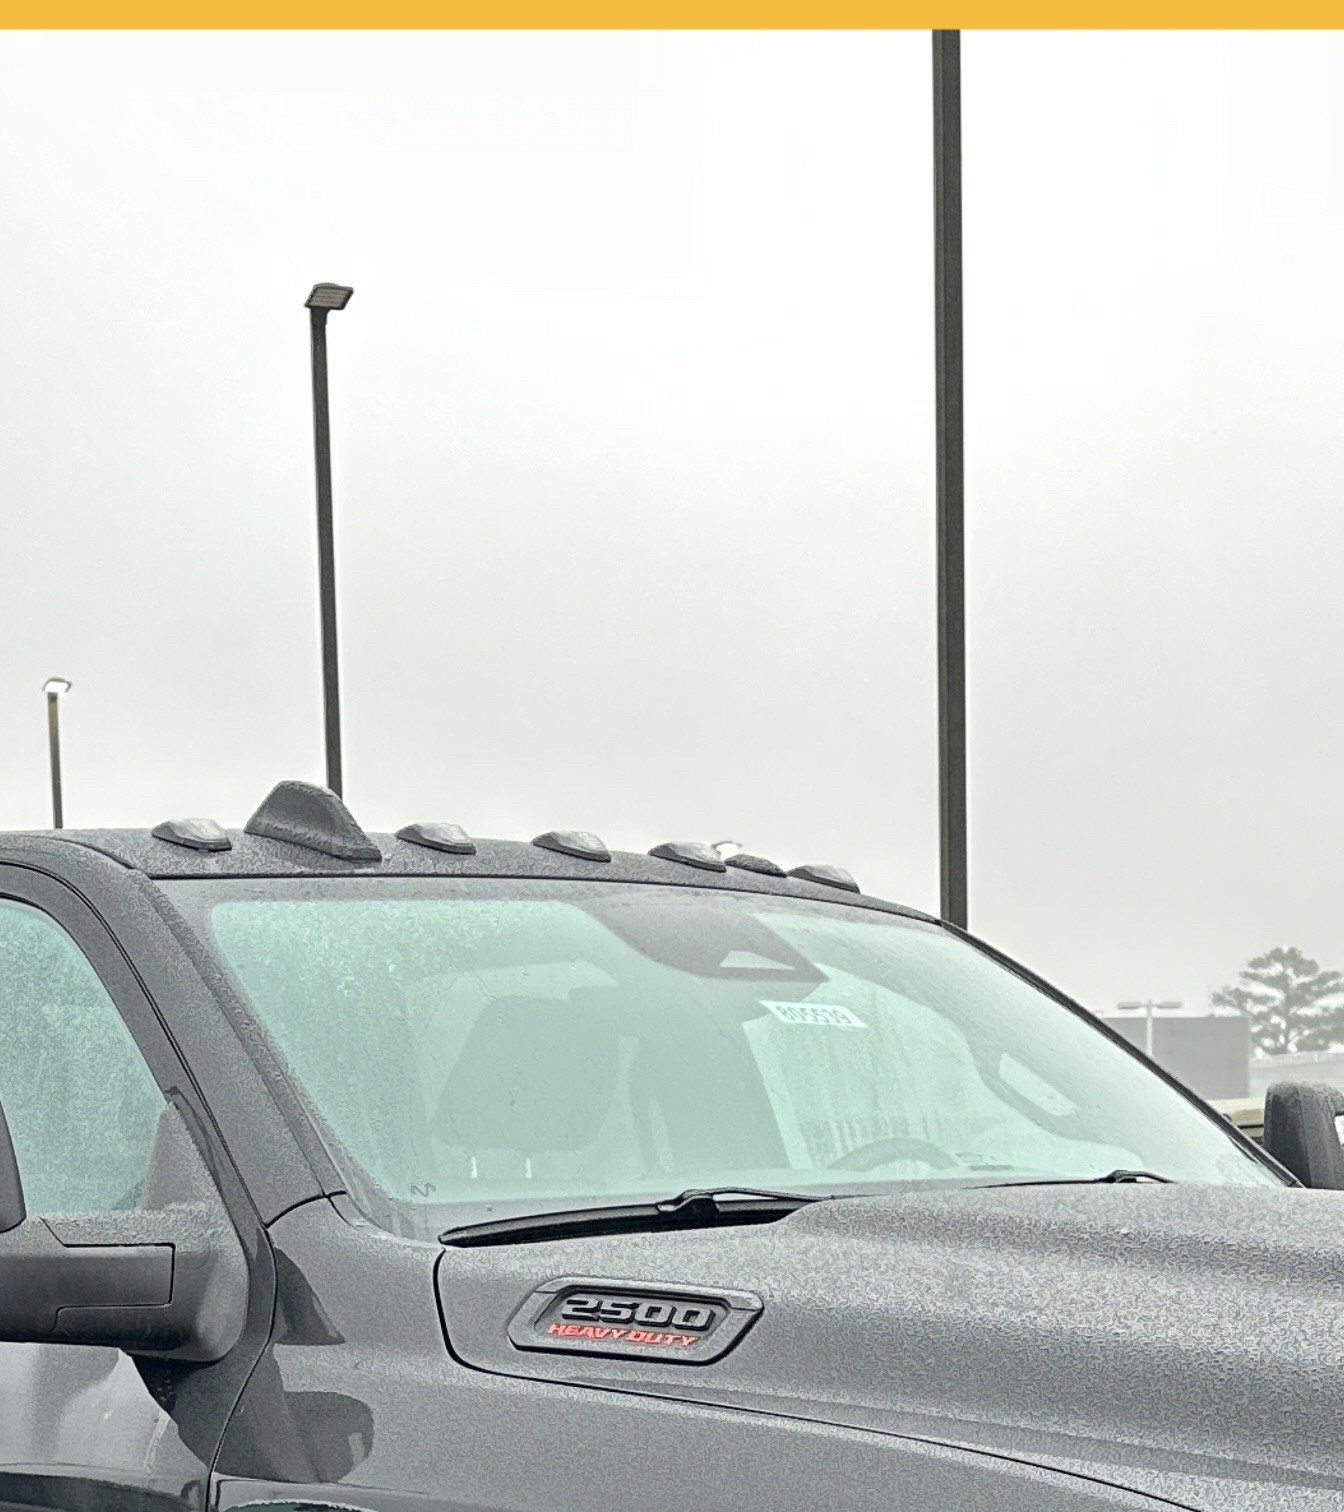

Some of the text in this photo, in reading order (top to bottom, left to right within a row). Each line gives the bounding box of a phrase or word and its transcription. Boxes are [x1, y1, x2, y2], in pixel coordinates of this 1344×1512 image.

[561, 1297, 716, 1332] 2500
[547, 1322, 701, 1347] HEAVY DUTY
